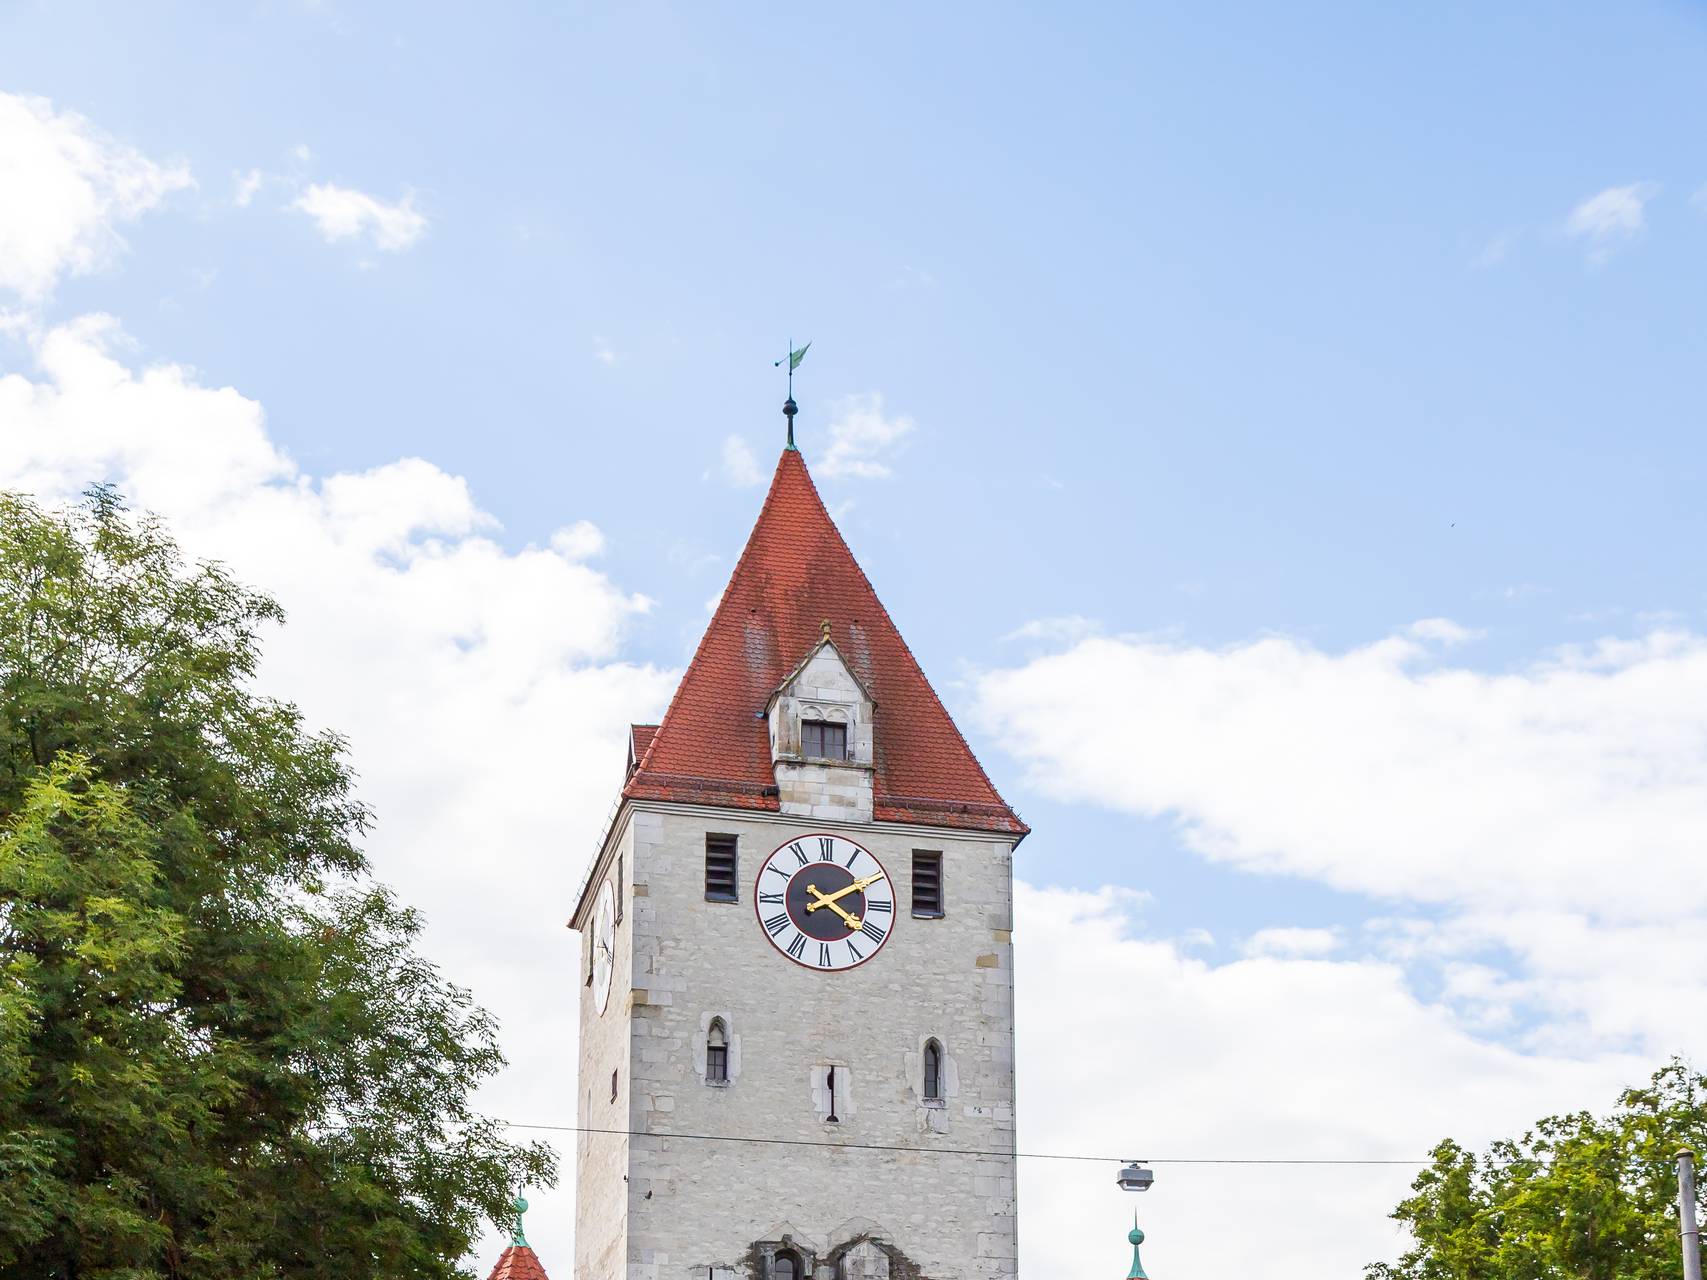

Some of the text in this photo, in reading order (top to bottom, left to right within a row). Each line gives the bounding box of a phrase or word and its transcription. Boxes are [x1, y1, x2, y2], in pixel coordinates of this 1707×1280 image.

[788, 842, 810, 867] XI
[818, 837, 834, 862] XII
[844, 847, 862, 869] I
[766, 862, 792, 882] X
[759, 891, 784, 905] IX
[868, 900, 892, 914] III
[764, 912, 790, 938] VIII
[786, 932, 808, 960] VII
[818, 942, 832, 967] VI
[846, 939, 865, 963] V
